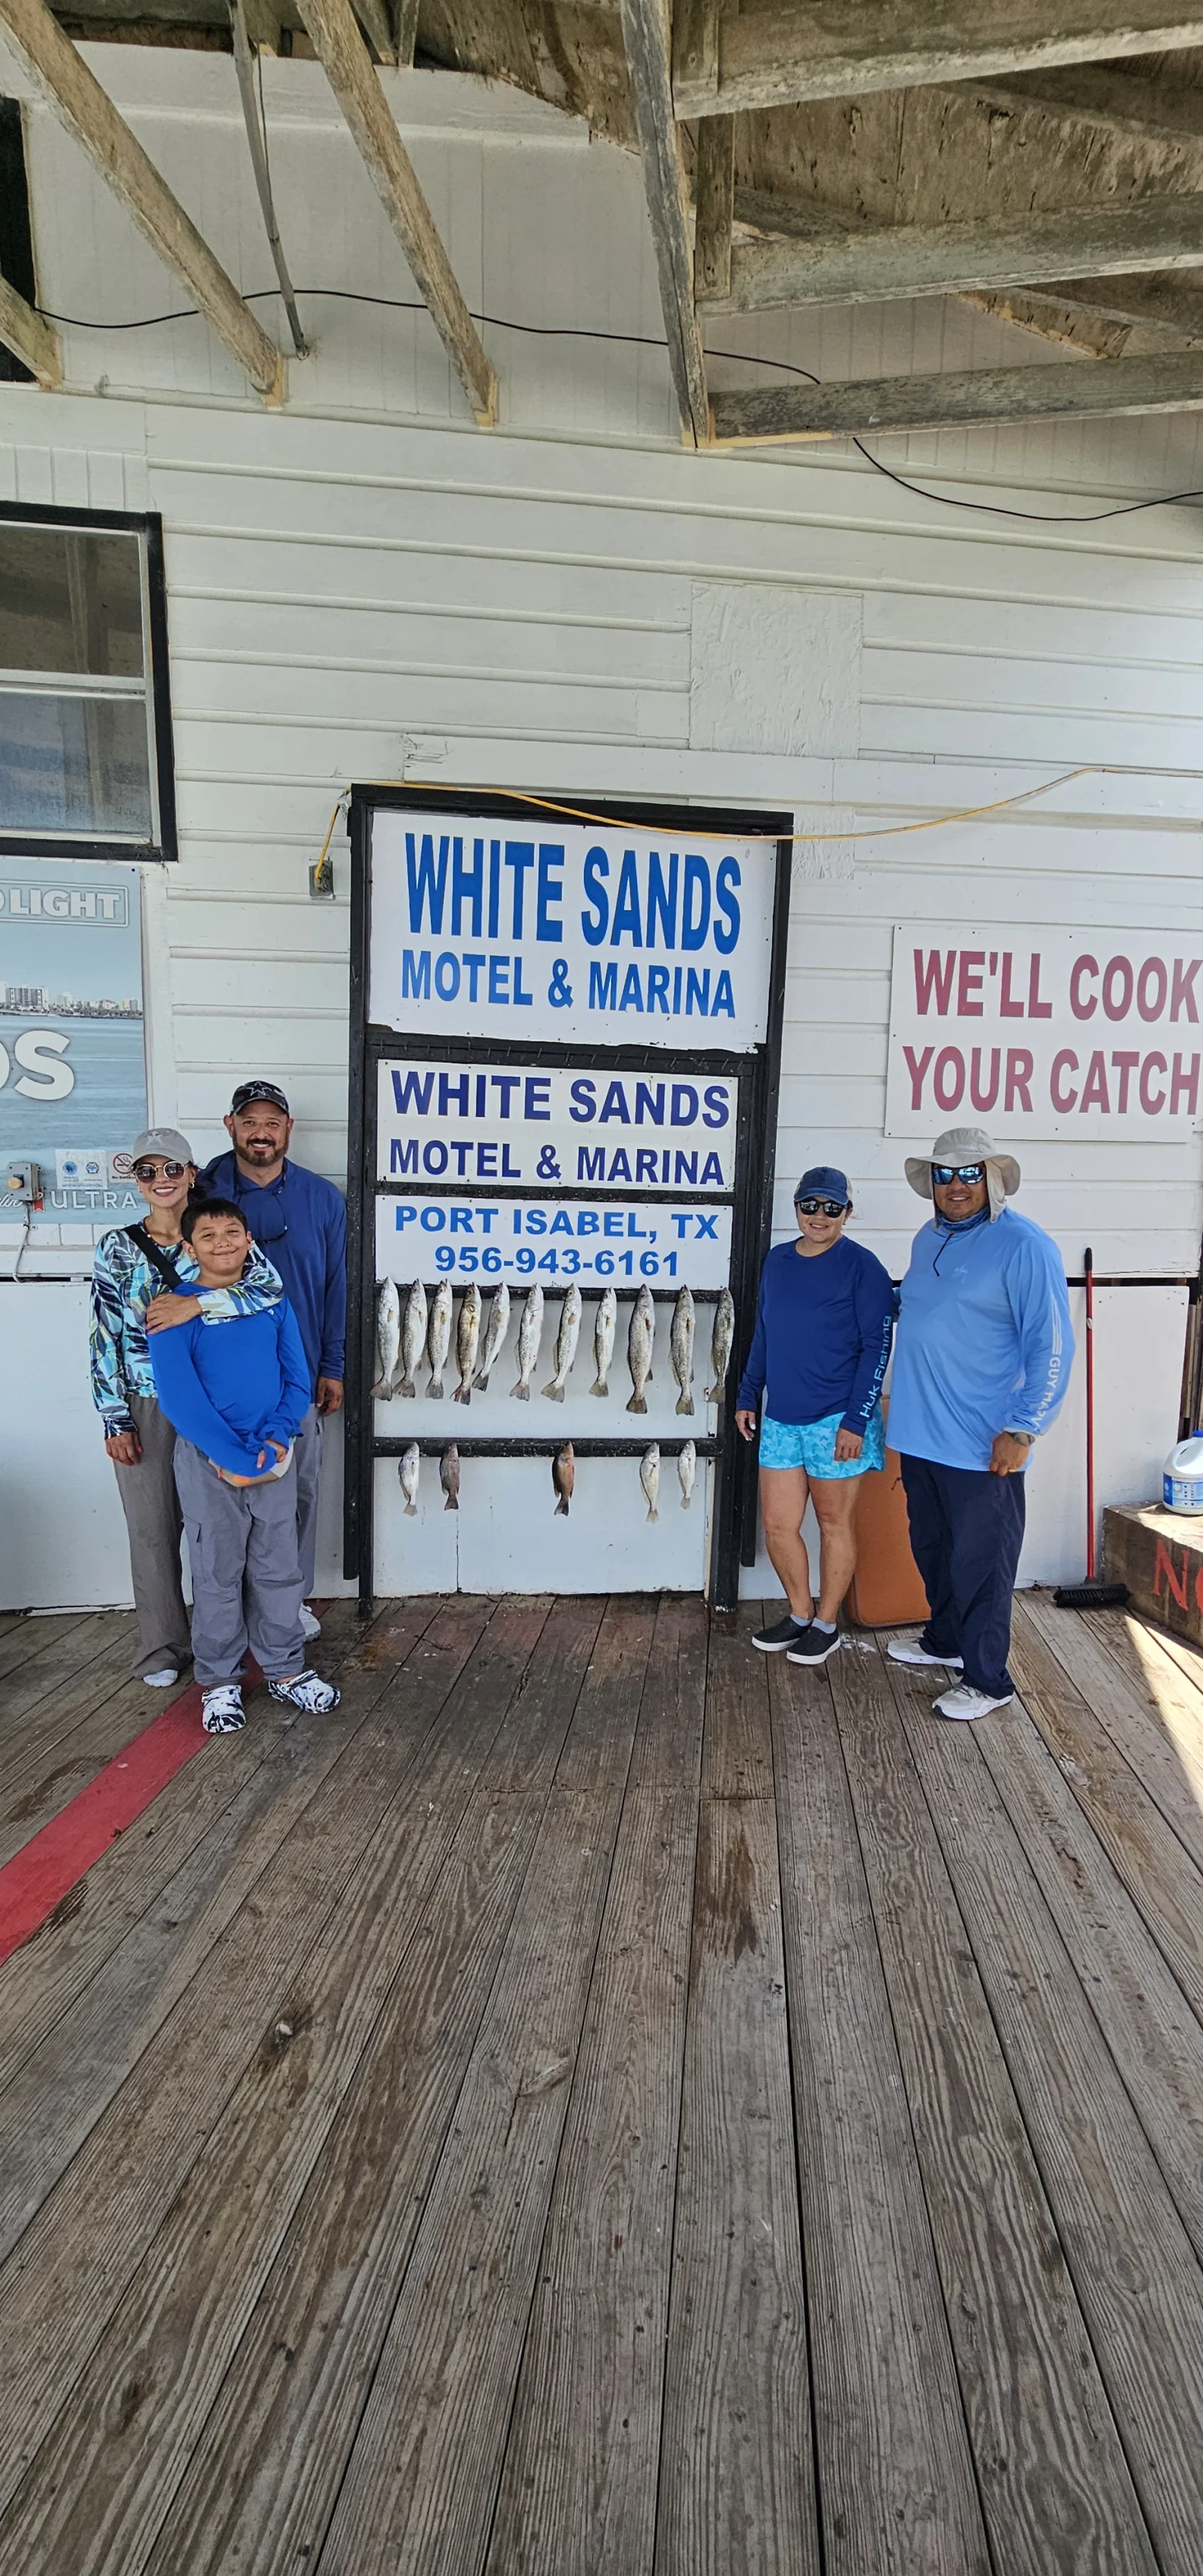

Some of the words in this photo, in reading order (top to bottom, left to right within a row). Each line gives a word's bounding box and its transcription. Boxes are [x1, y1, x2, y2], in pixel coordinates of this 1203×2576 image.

[9, 888, 120, 919] LIGHT
[405, 832, 565, 943] WHITE
[580, 846, 741, 955] SANDS
[402, 949, 533, 1007] MOTEL
[547, 958, 574, 1008] &
[588, 961, 735, 1018] MARINA
[914, 949, 1053, 1018] WE'LL
[1069, 954, 1203, 1023] COOK
[0, 1029, 74, 1101] S
[902, 1046, 1034, 1113] YOUR
[1050, 1049, 1201, 1115] CATCH
[390, 1070, 551, 1121] WHITE
[568, 1079, 730, 1129] SANDS
[389, 1138, 521, 1179] MOTEL
[536, 1144, 562, 1180] &
[577, 1146, 725, 1186] MARINA
[51, 1190, 138, 1209] ULTRA
[395, 1205, 498, 1235] PORT
[513, 1208, 658, 1244] ISABEL,
[671, 1214, 719, 1240] TX
[435, 1245, 677, 1277] 956-943-6161
[859, 1384, 880, 1418] Huk
[874, 1316, 892, 1381] Fishing
[1046, 1356, 1061, 1389] GUY
